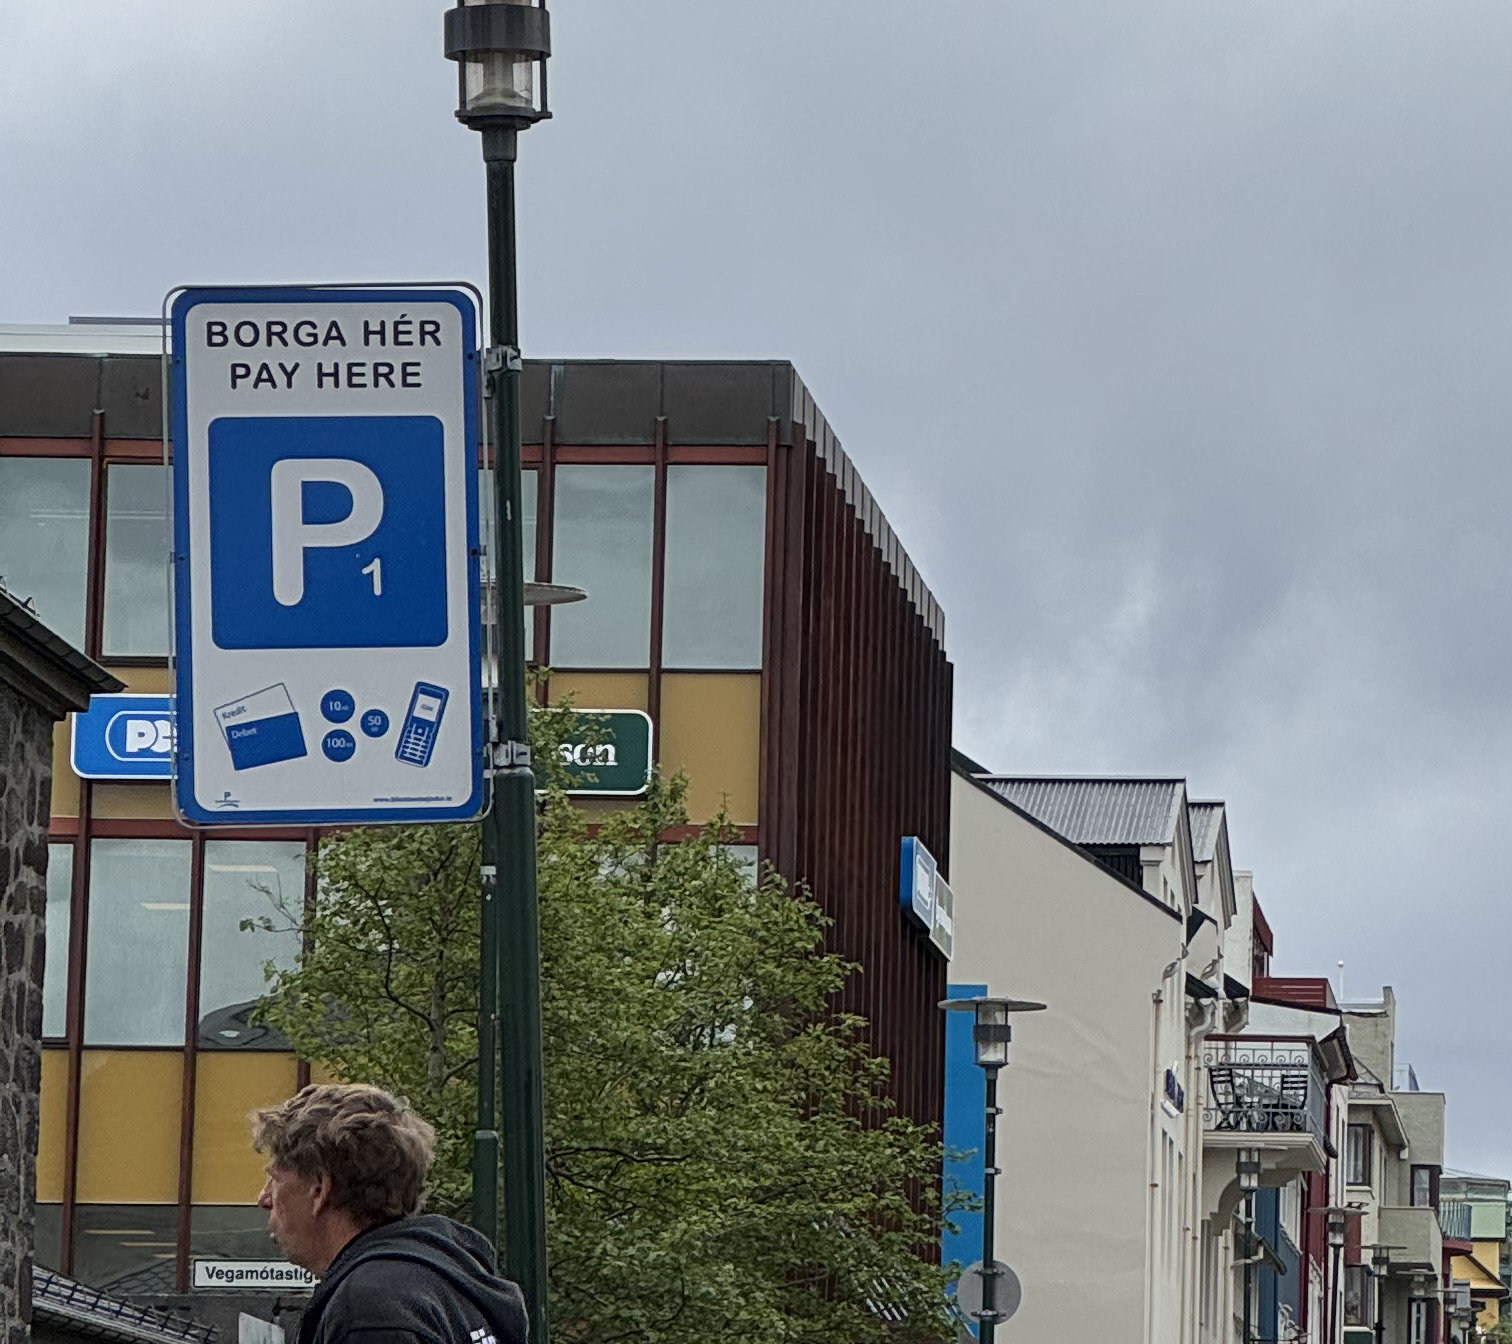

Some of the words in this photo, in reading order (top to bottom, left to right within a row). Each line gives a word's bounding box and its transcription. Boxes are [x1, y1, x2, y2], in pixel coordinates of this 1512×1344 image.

[206, 320, 347, 348] BORGA
[363, 313, 442, 347] HÉR
[231, 362, 300, 389] PAY
[317, 361, 422, 388] HERE
[271, 458, 385, 607] P
[361, 558, 383, 597] 1
[329, 701, 341, 712] 10
[367, 715, 382, 726] 50
[326, 737, 346, 748] 100
